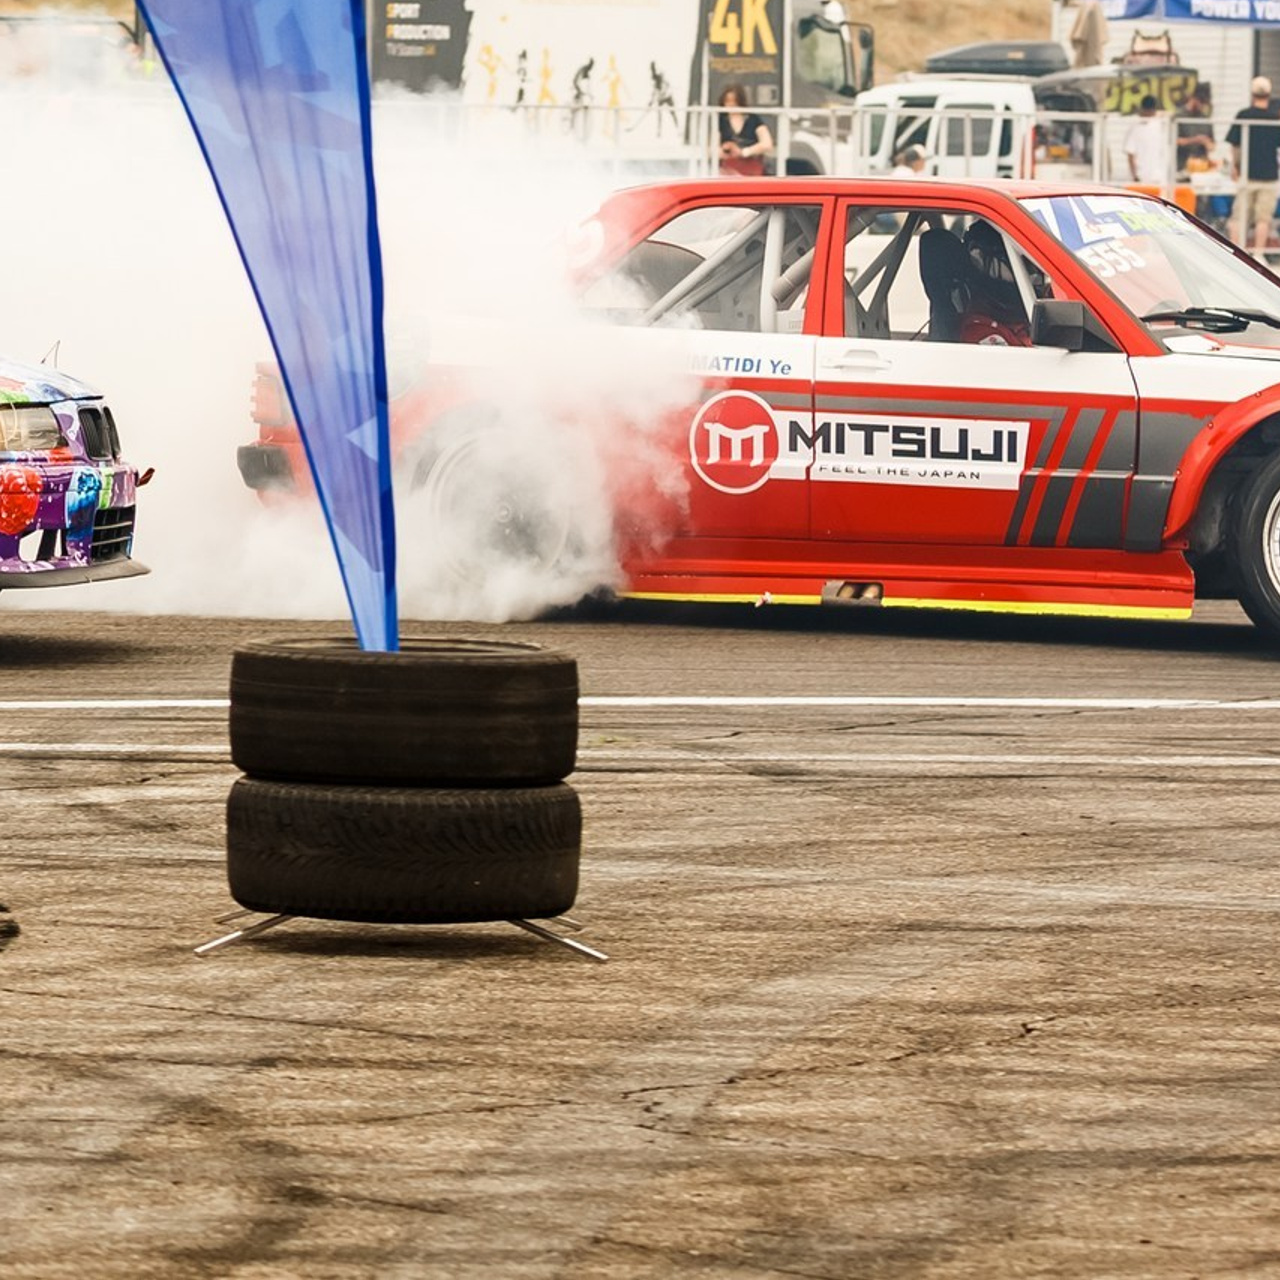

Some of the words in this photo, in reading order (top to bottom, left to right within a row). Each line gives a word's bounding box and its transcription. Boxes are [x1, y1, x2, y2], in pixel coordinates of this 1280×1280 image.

[769, 358, 792, 376] Ye
[789, 420, 1018, 463] MITSUJI
[819, 465, 867, 475] FEEL
[876, 466, 910, 477] THE
[917, 468, 981, 480] JAPAN
